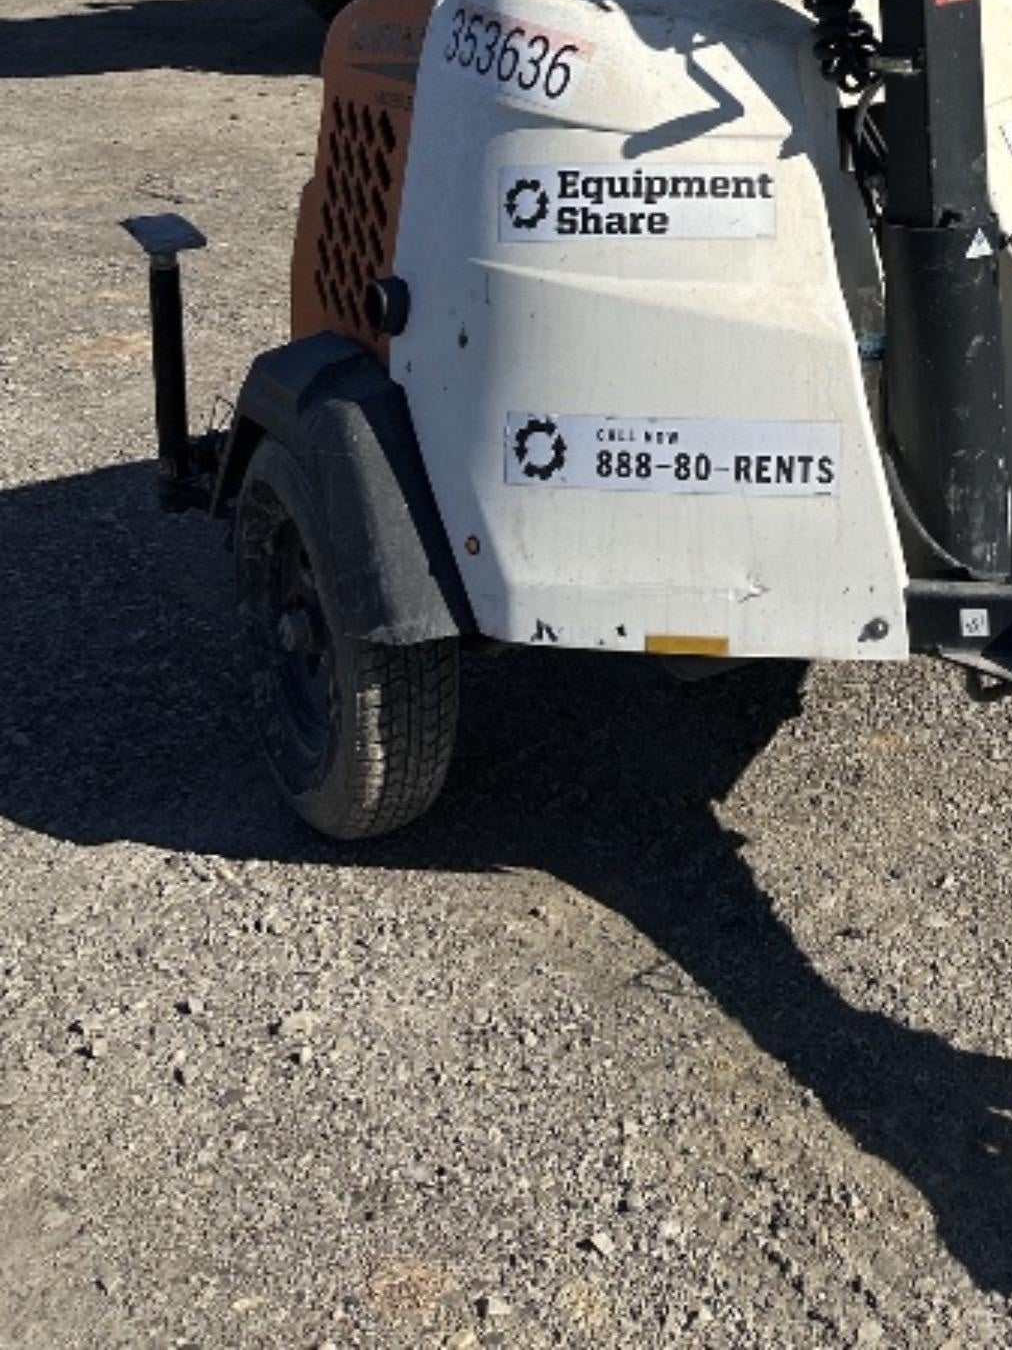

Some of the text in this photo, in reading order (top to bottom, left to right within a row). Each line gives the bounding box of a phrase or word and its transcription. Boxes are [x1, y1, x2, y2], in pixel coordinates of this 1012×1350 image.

[444, 8, 580, 100] 353636
[557, 169, 775, 204] Equipment
[557, 206, 669, 235] Share
[595, 449, 835, 485] 888-80-RENTS
